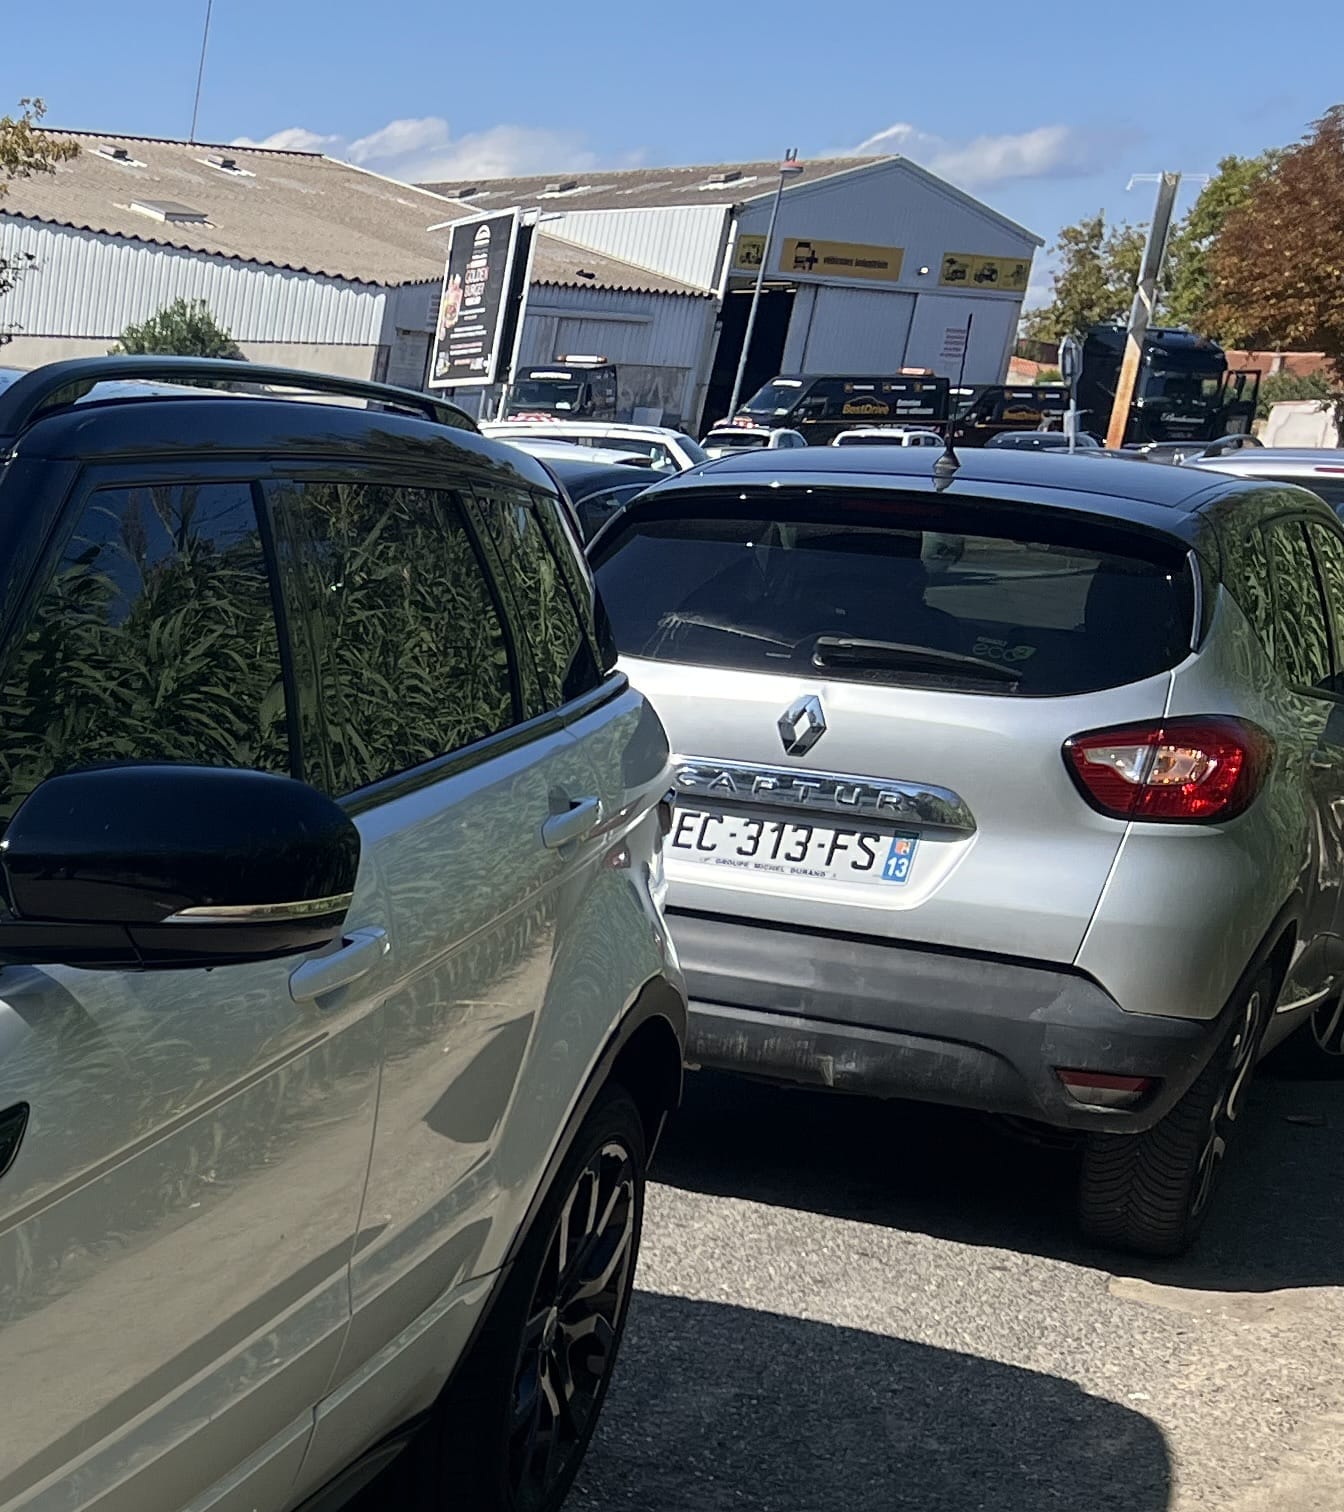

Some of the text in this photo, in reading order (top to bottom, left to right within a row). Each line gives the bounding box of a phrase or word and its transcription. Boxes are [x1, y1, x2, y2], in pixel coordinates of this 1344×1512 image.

[676, 766, 905, 812] CAPTUR
[672, 811, 880, 871] EC-313-FS
[887, 856, 909, 878] 13
